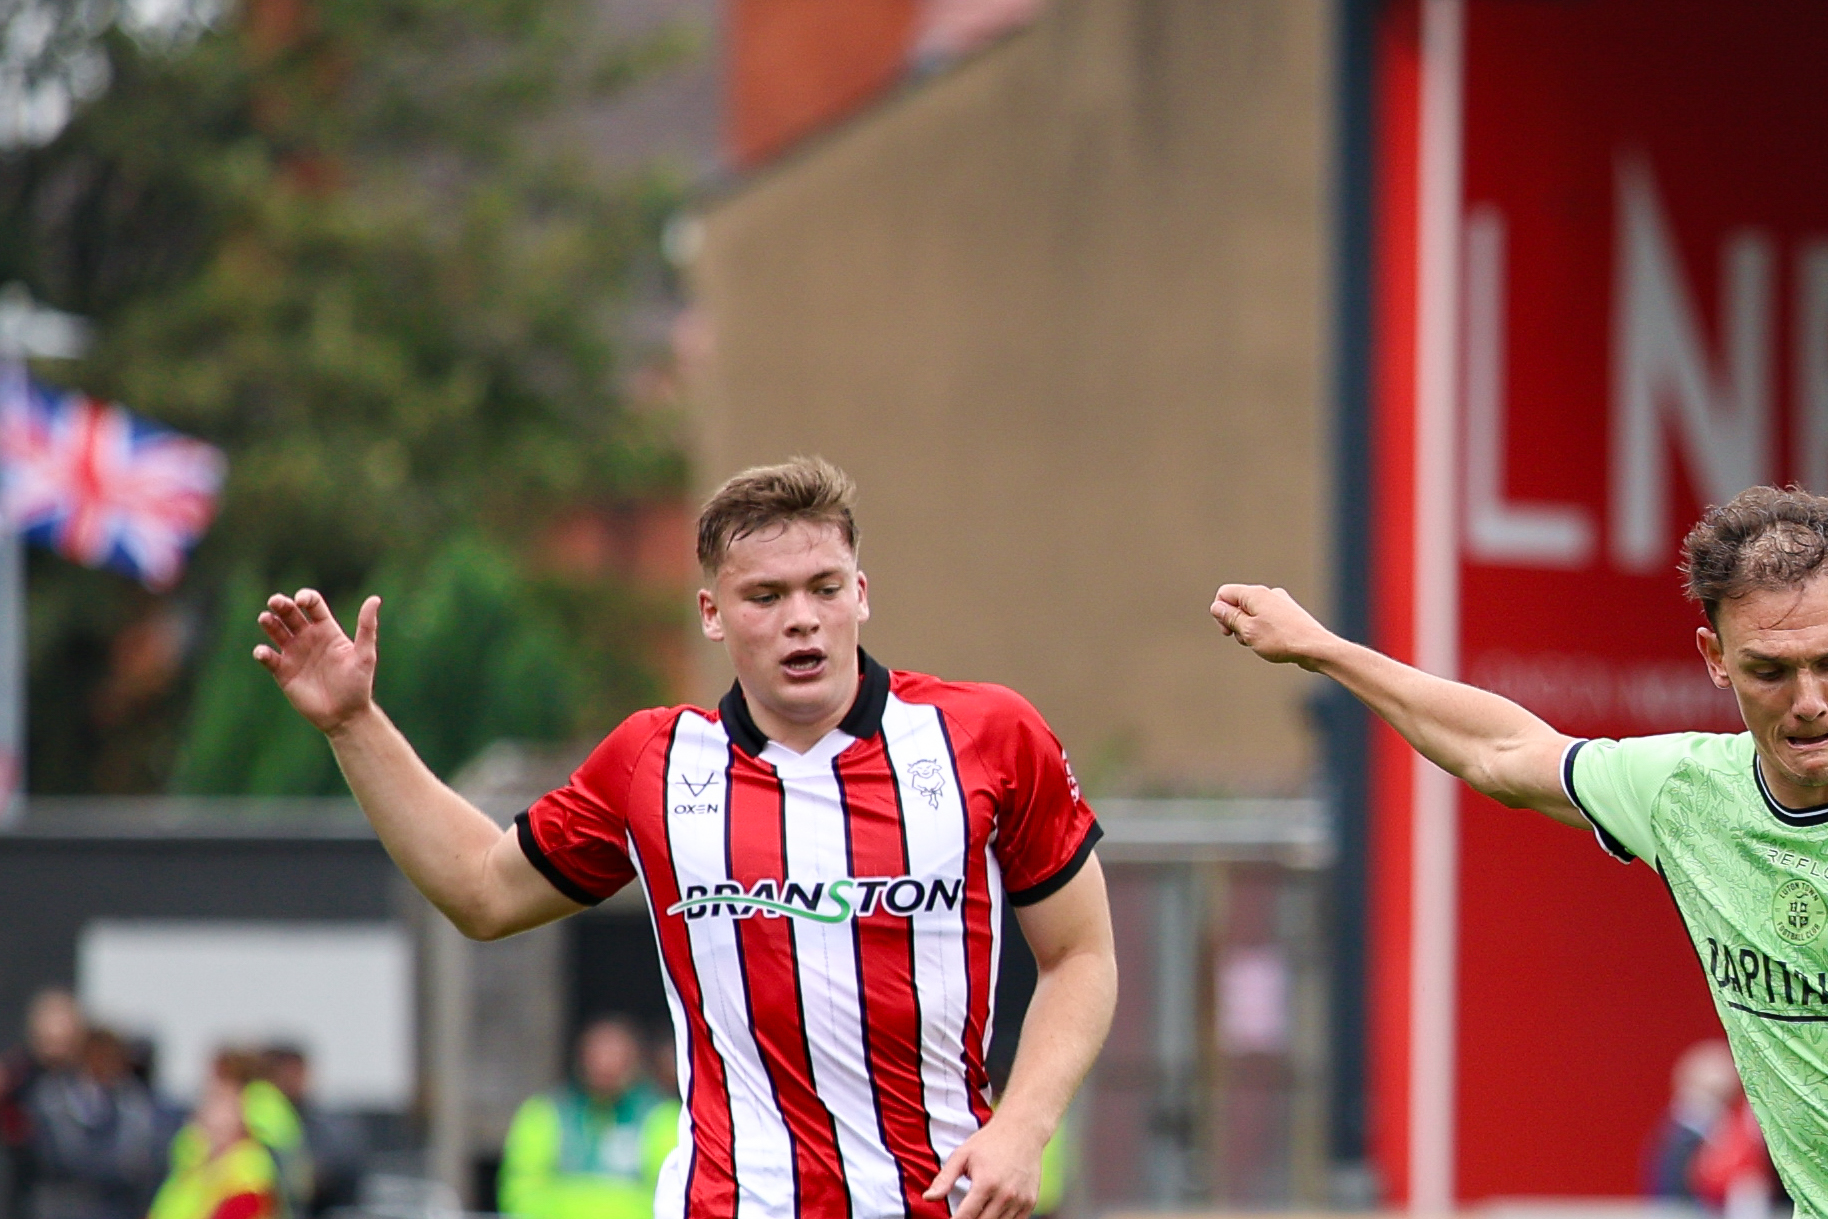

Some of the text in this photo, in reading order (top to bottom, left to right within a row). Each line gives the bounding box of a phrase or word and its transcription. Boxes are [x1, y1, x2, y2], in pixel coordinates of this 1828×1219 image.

[674, 803, 719, 815] OXEN
[668, 878, 962, 924] BRANSTON
[1779, 881, 1819, 902] LUTON TOWN
[1776, 921, 1821, 941] FOOTBALL CLUB
